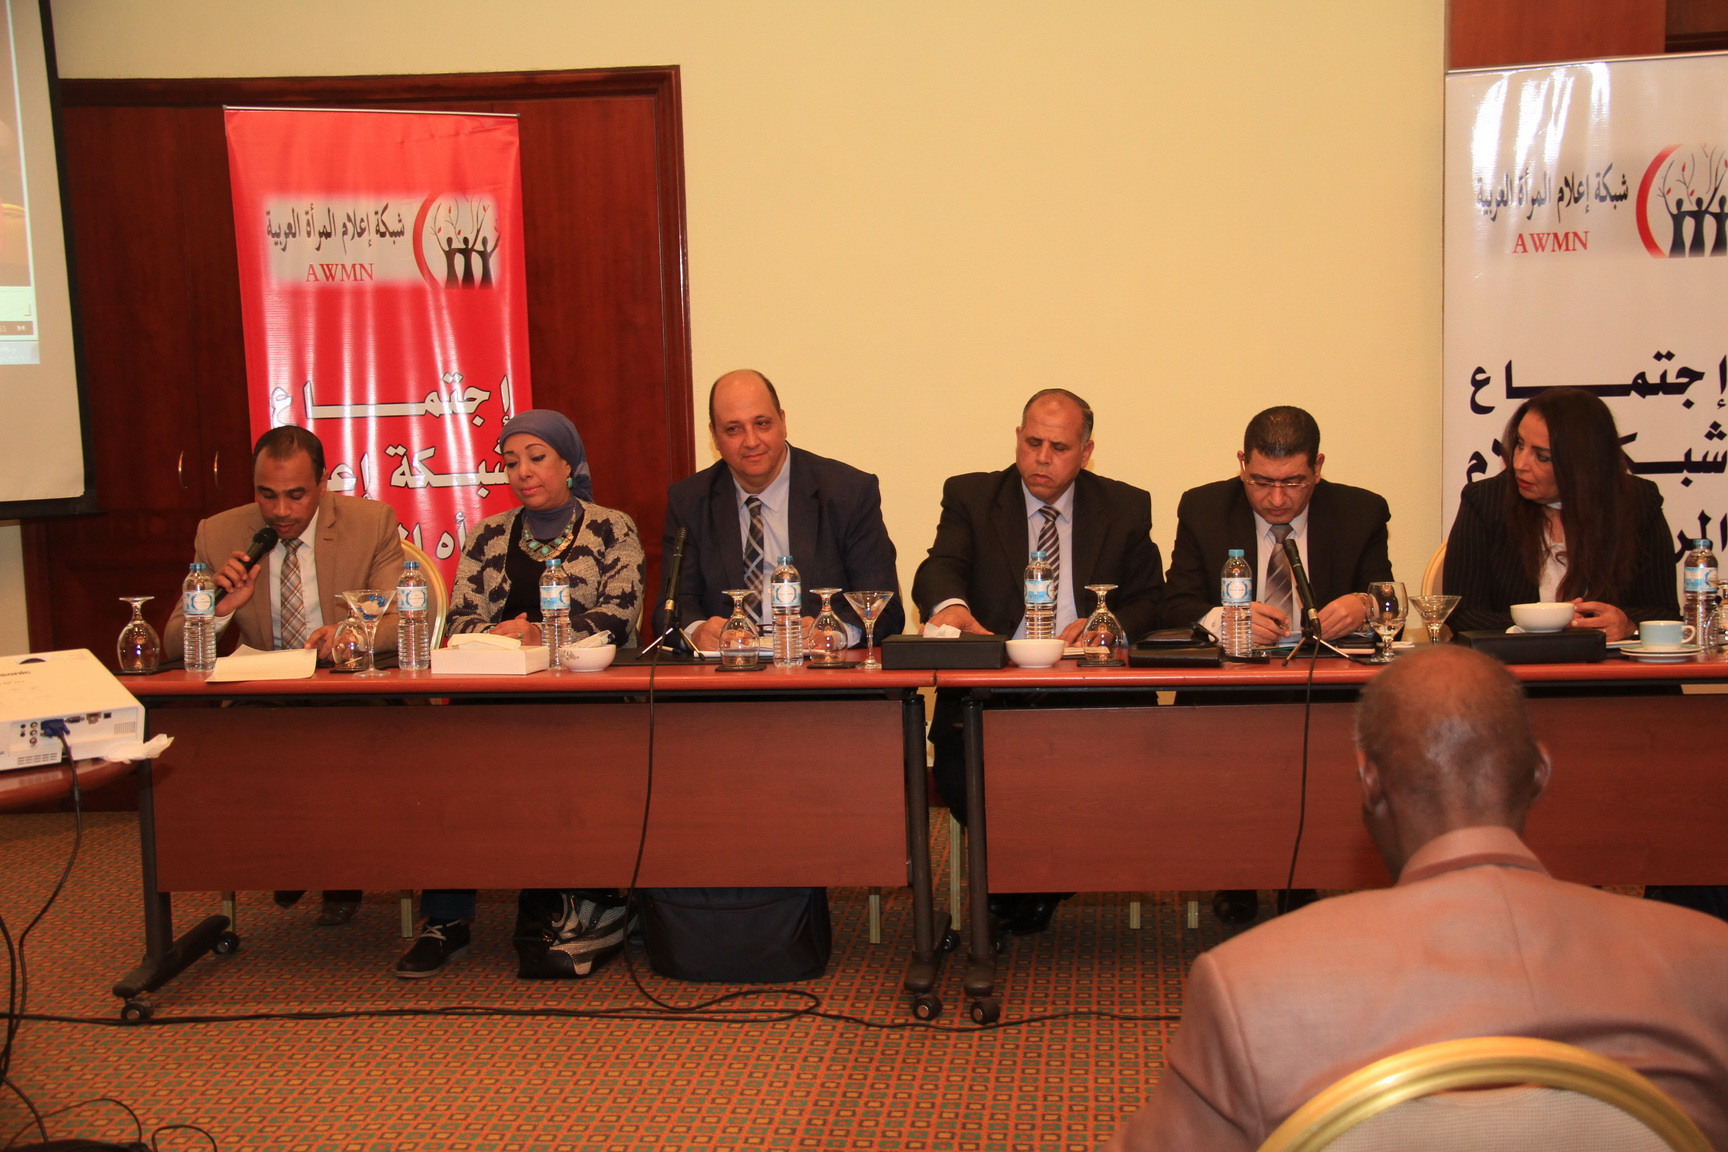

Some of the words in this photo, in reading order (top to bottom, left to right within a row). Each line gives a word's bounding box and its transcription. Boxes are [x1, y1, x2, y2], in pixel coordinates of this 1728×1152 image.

[1476, 171, 1513, 222] العربية
[1518, 167, 1551, 221] المرأة
[1556, 171, 1590, 224] إعلام
[1594, 162, 1629, 210] شبكة
[265, 206, 301, 252] العربية
[304, 202, 337, 252] المرأة
[341, 208, 372, 256] إعلام
[374, 202, 405, 246] شبكة
[1512, 230, 1590, 254] AWMN
[305, 262, 374, 282] AWMN
[270, 371, 511, 430] إجتماع
[1469, 350, 1728, 415] إجتماع
